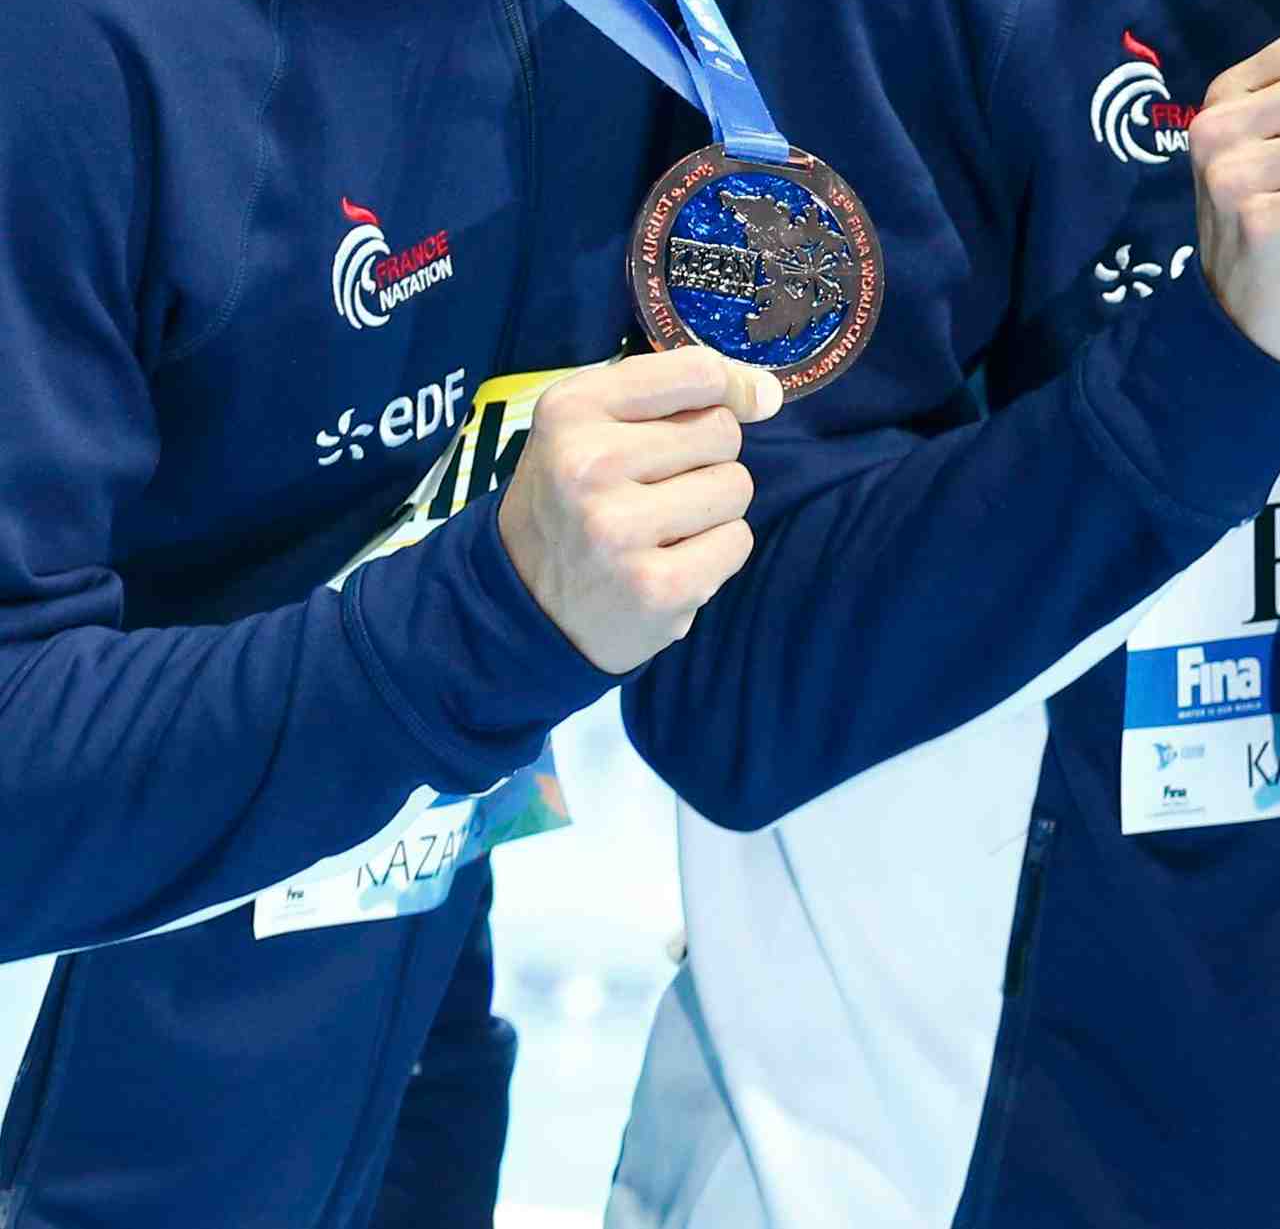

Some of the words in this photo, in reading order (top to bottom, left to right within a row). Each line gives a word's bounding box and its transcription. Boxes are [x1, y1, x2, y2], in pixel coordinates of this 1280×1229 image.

[1152, 103, 1204, 130] FRA
[375, 229, 450, 289] FRANCE
[642, 193, 674, 266] AUGUST
[379, 254, 454, 311] NATATION
[782, 324, 862, 391] CHAMPIONS
[379, 368, 466, 448] eDF
[1177, 646, 1262, 709] Fina
